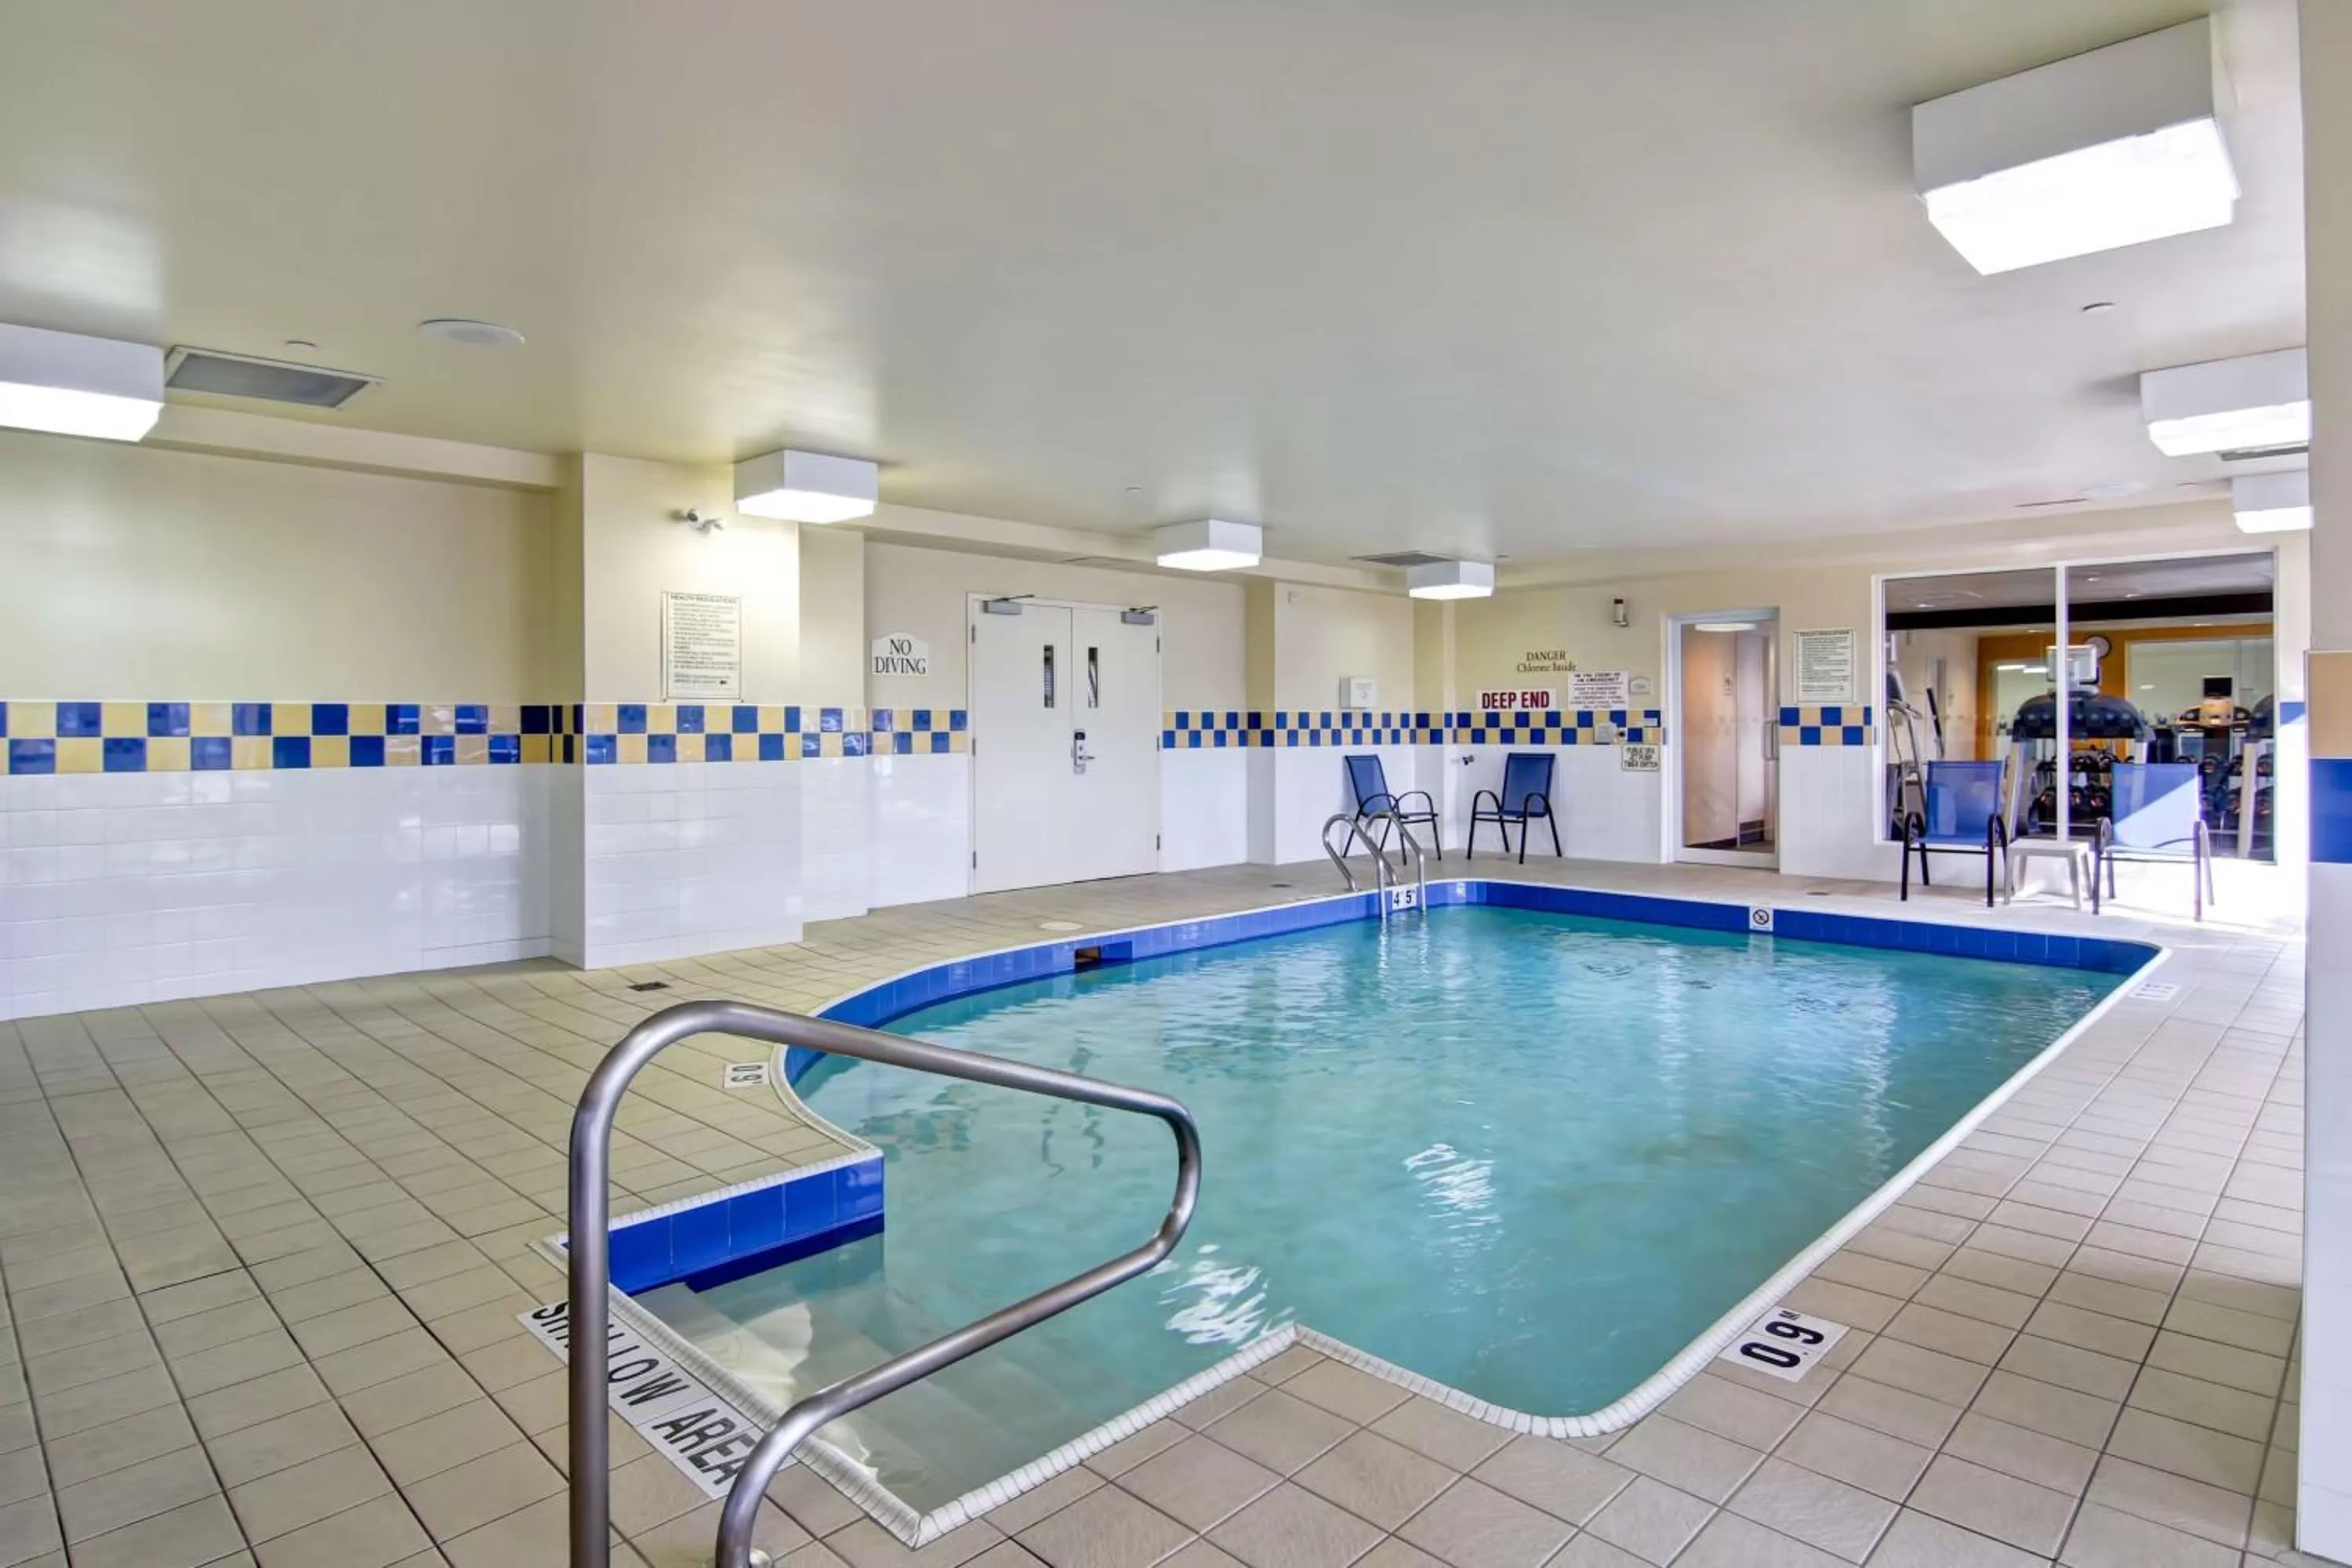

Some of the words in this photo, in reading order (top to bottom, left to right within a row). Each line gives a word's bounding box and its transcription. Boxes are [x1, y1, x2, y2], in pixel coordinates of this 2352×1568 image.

[889, 638, 912, 655] NO
[874, 656, 926, 674] DIVING
[1526, 651, 1566, 662] DANGER
[1482, 691, 1516, 709] DEEP
[1521, 691, 1550, 708] END
